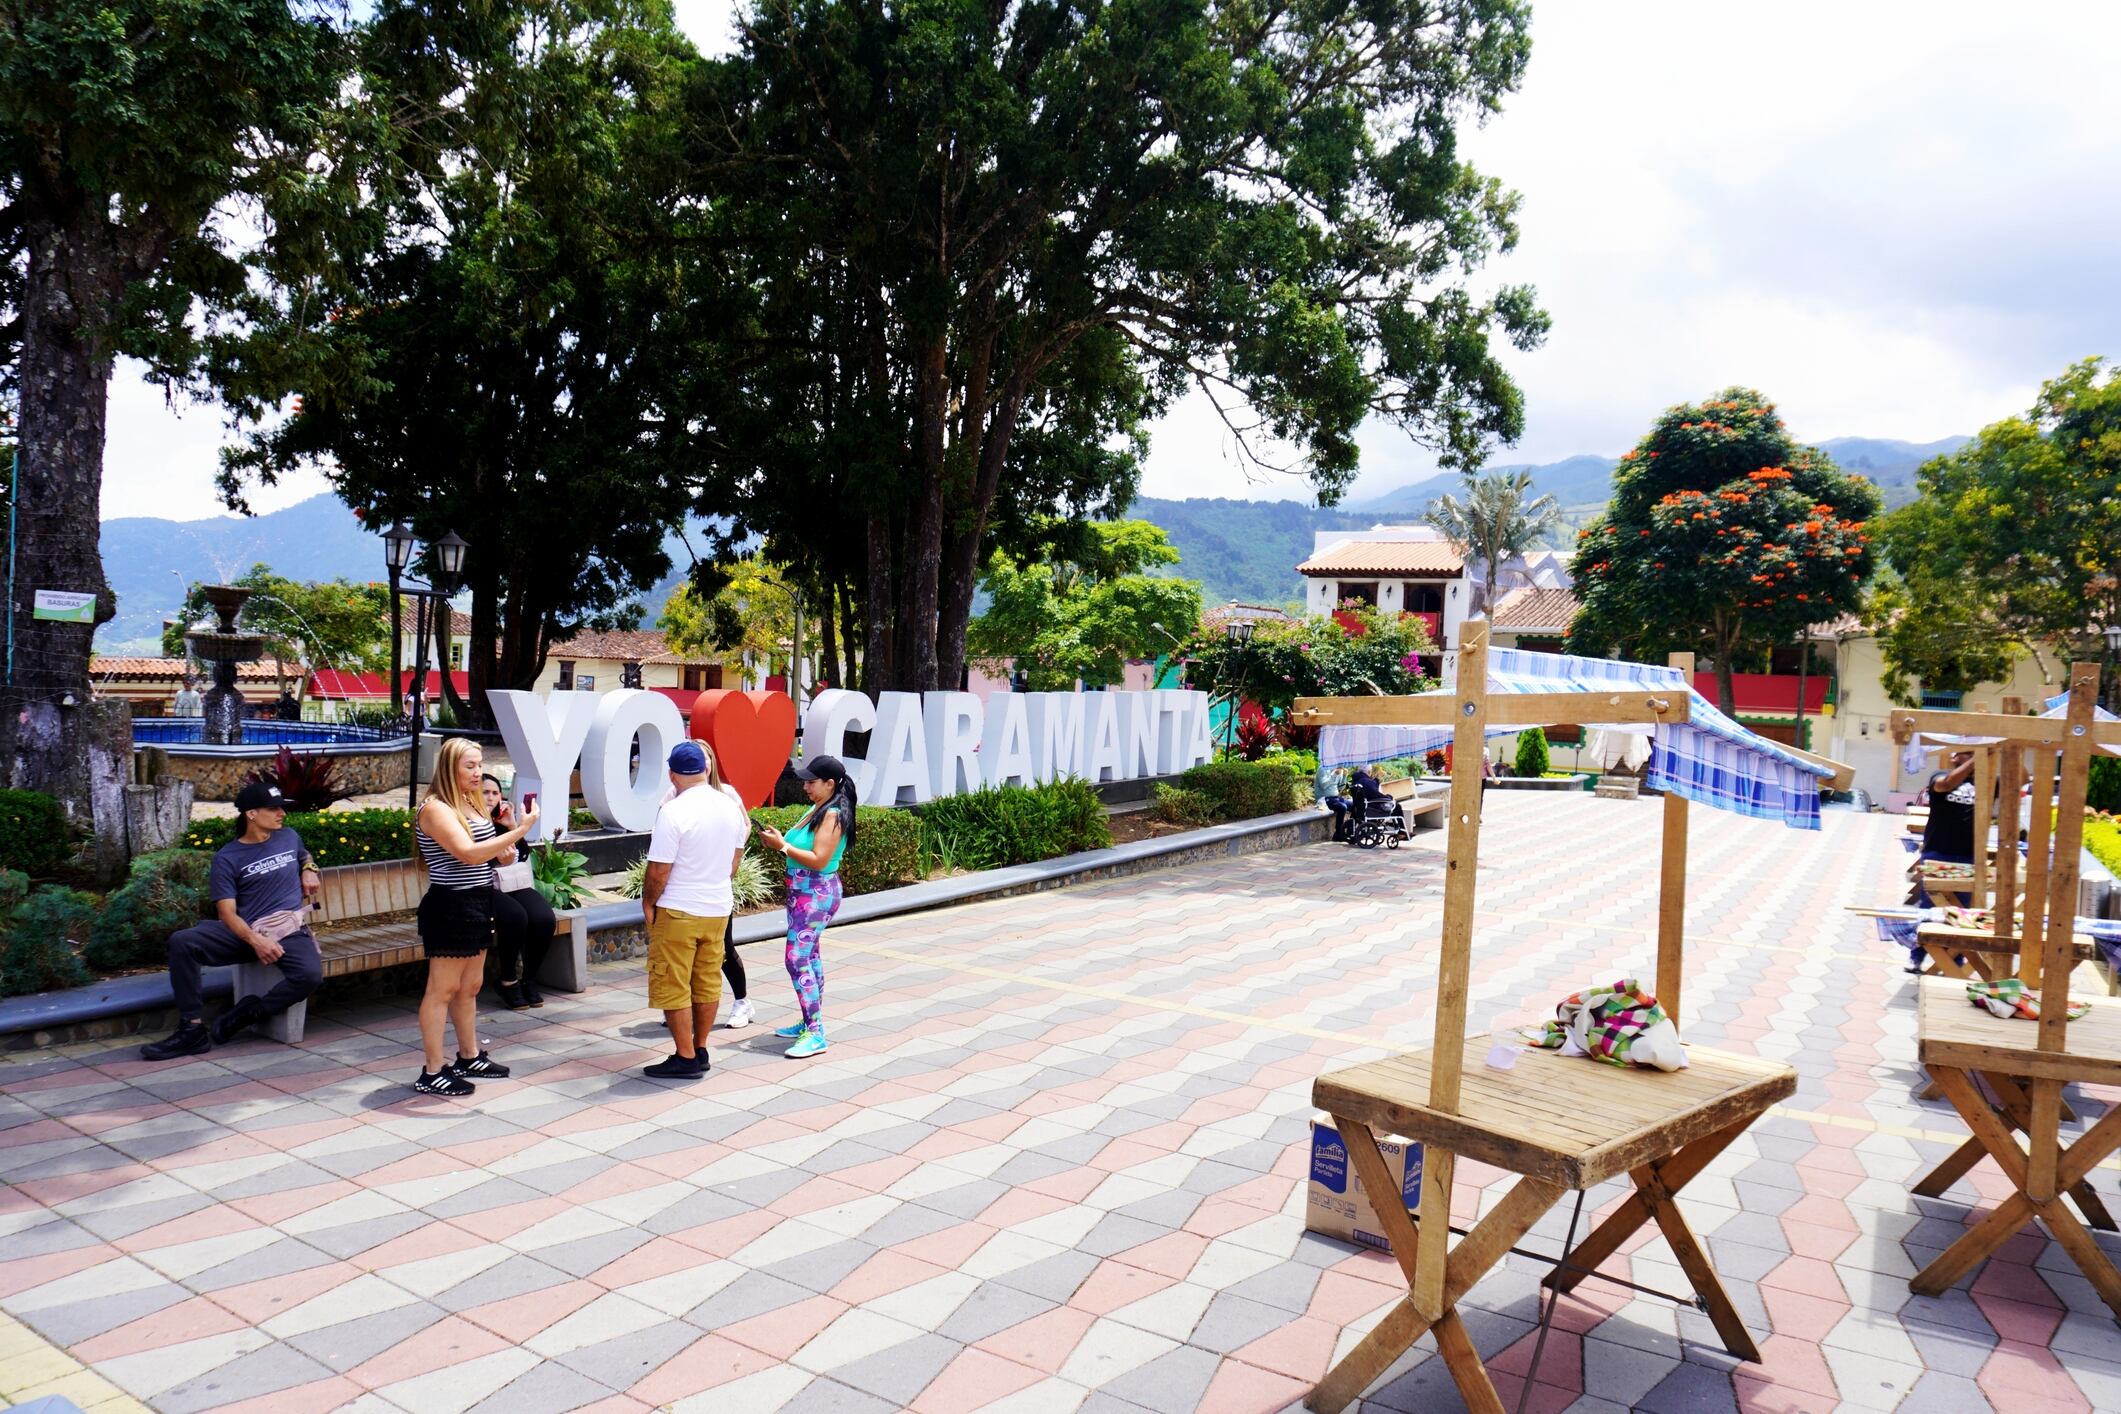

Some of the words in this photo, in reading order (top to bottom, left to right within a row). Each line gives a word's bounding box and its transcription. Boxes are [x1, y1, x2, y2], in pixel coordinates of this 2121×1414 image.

[47, 599, 80, 607] BASURAS
[486, 688, 686, 842] YO
[801, 688, 1213, 808] CARAMANTA
[248, 860, 275, 873] Calvin
[275, 854, 293, 864] Klein
[1314, 1160, 1343, 1175] Servilleta
